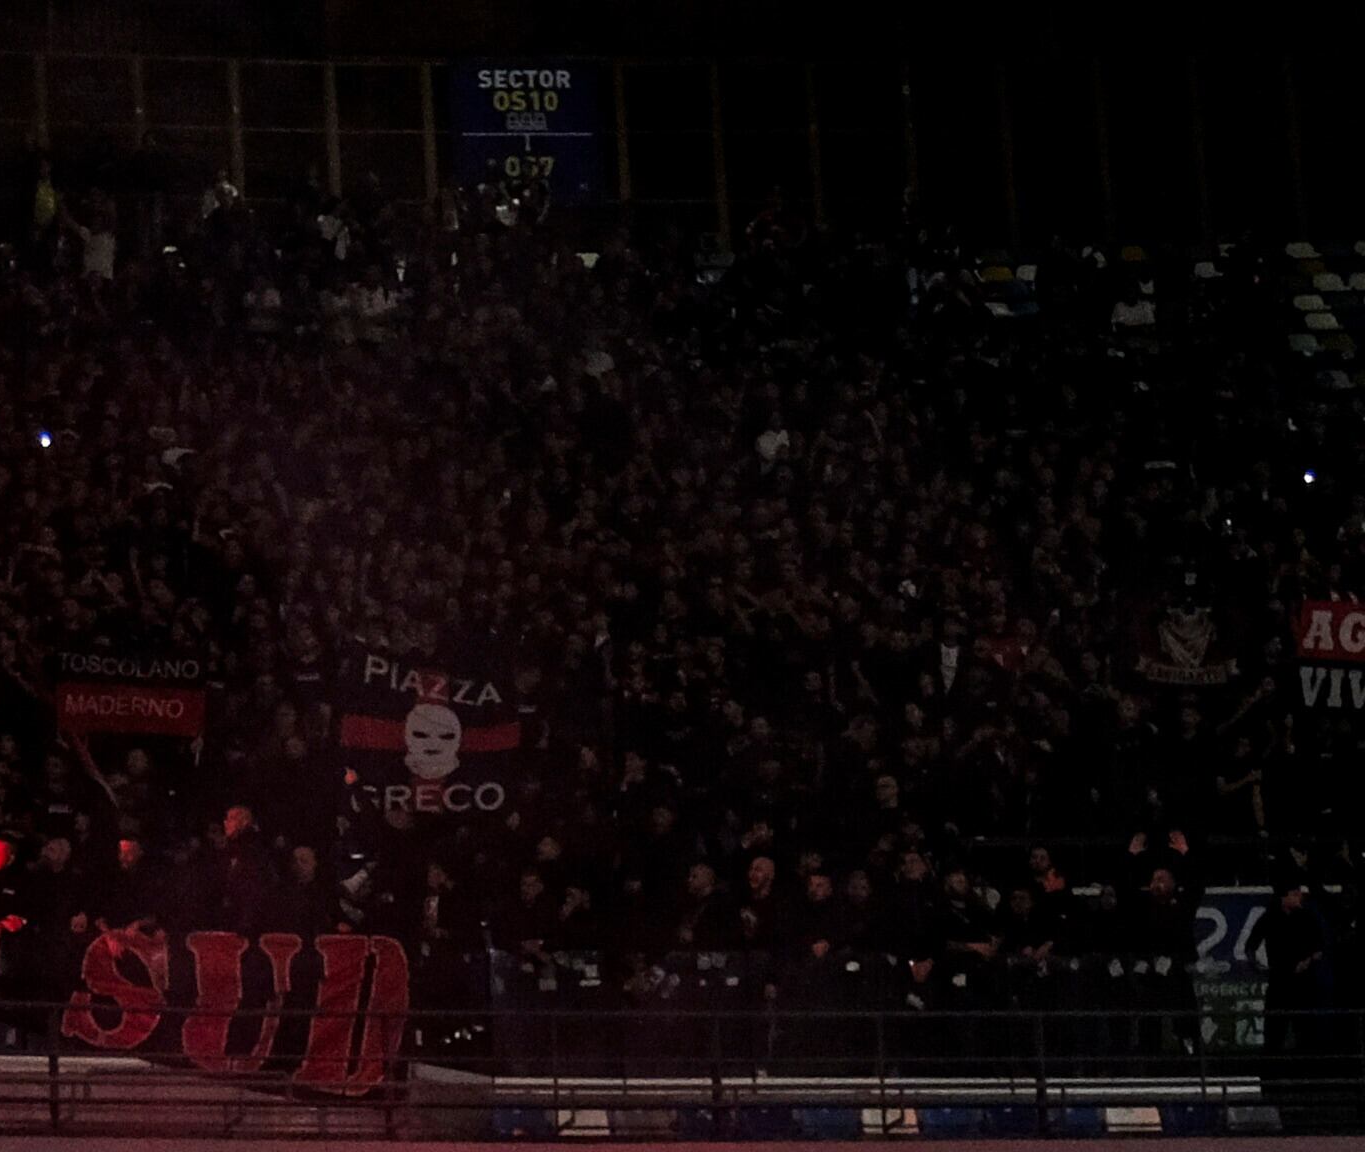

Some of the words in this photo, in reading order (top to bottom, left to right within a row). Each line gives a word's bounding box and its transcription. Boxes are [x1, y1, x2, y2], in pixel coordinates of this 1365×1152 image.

[477, 70, 572, 89] SECTOR
[58, 651, 202, 681] TOSCOLANO
[363, 654, 503, 708] PIAZZA
[63, 693, 186, 720] MADERNO
[61, 918, 410, 1097] SUD
